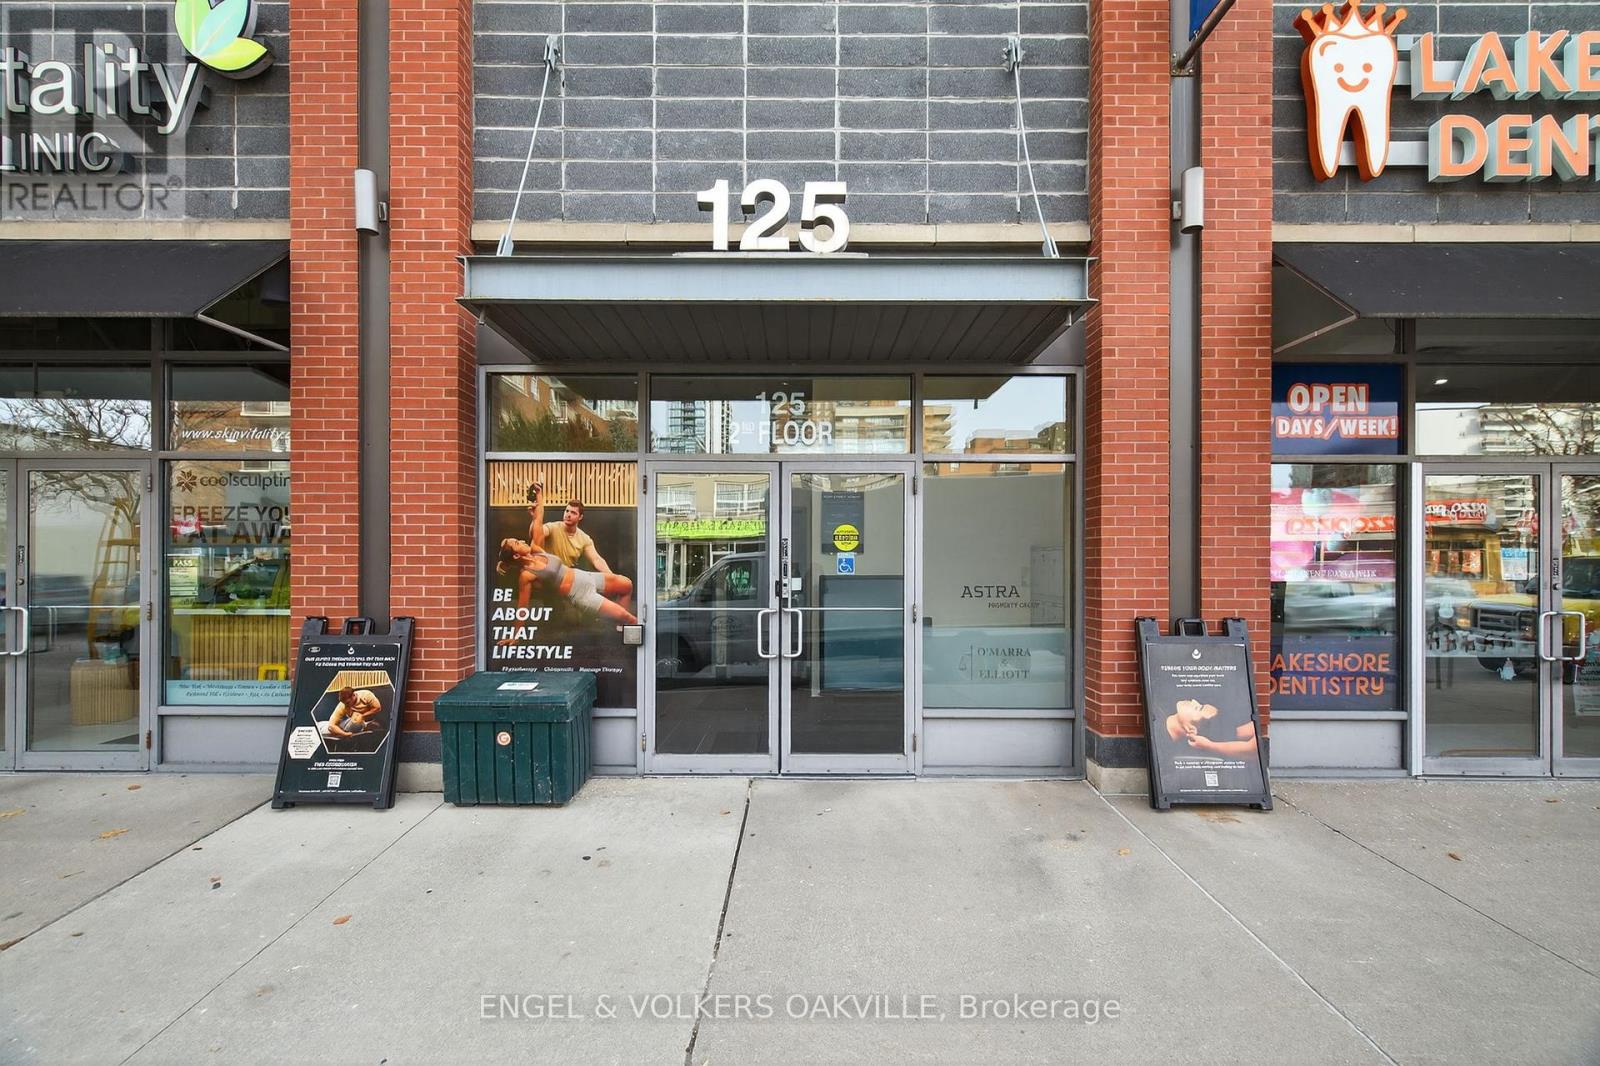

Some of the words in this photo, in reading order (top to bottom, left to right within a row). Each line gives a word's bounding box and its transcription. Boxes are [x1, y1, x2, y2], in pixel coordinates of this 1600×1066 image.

[1437, 114, 1600, 176] DEN
[697, 178, 850, 254] 125
[756, 391, 805, 416] 125
[1288, 384, 1368, 414] OPEN
[759, 420, 833, 446] FLOOR
[173, 506, 249, 521] FREEZE
[493, 588, 513, 602] BE
[961, 585, 1020, 598] ASTRA
[491, 607, 552, 621] ABOUT
[493, 626, 537, 640] THAT
[492, 645, 573, 660] LIFESTYLE
